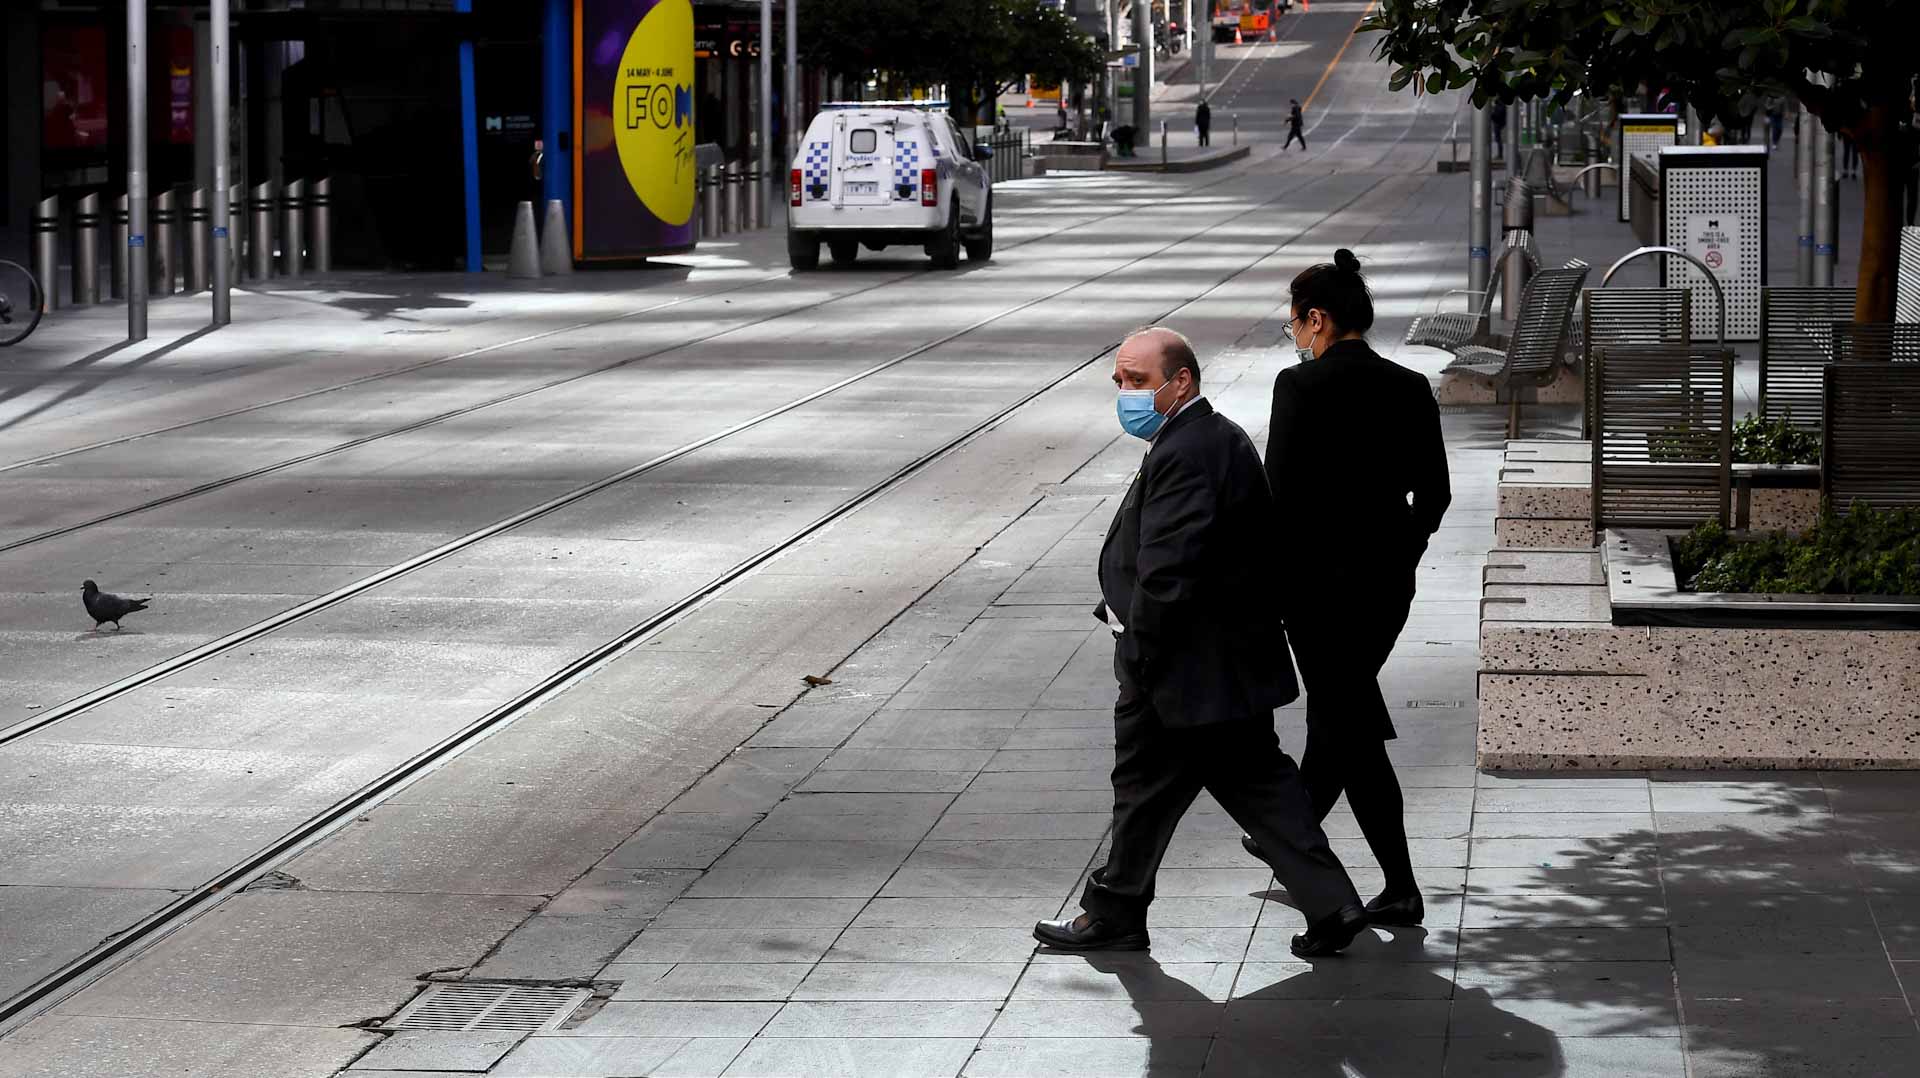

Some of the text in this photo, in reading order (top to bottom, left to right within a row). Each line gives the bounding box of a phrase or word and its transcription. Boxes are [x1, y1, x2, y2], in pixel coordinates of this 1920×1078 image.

[626, 68, 635, 78] 14
[636, 67, 651, 77] MAY
[846, 154, 881, 162] Police
